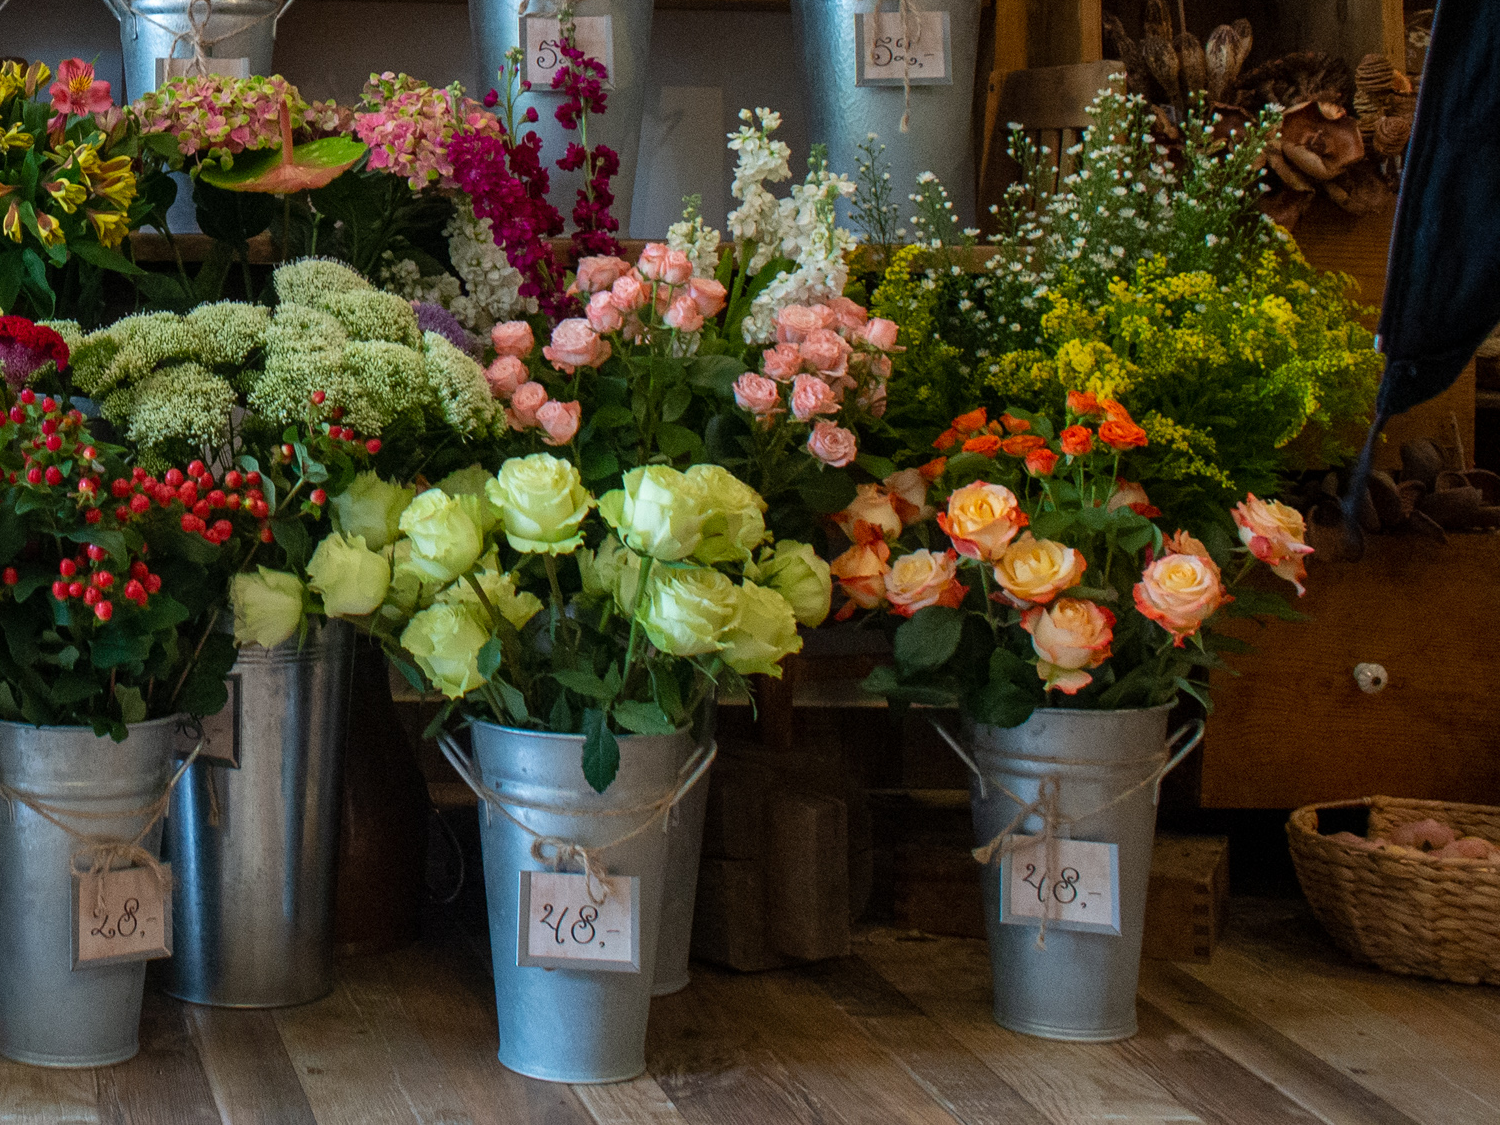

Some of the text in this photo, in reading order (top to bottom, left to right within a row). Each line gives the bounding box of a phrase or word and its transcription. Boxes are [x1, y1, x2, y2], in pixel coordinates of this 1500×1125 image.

[1022, 862, 1102, 909] 48,-
[90, 897, 157, 939] 28,-
[540, 902, 620, 948] 48,-
